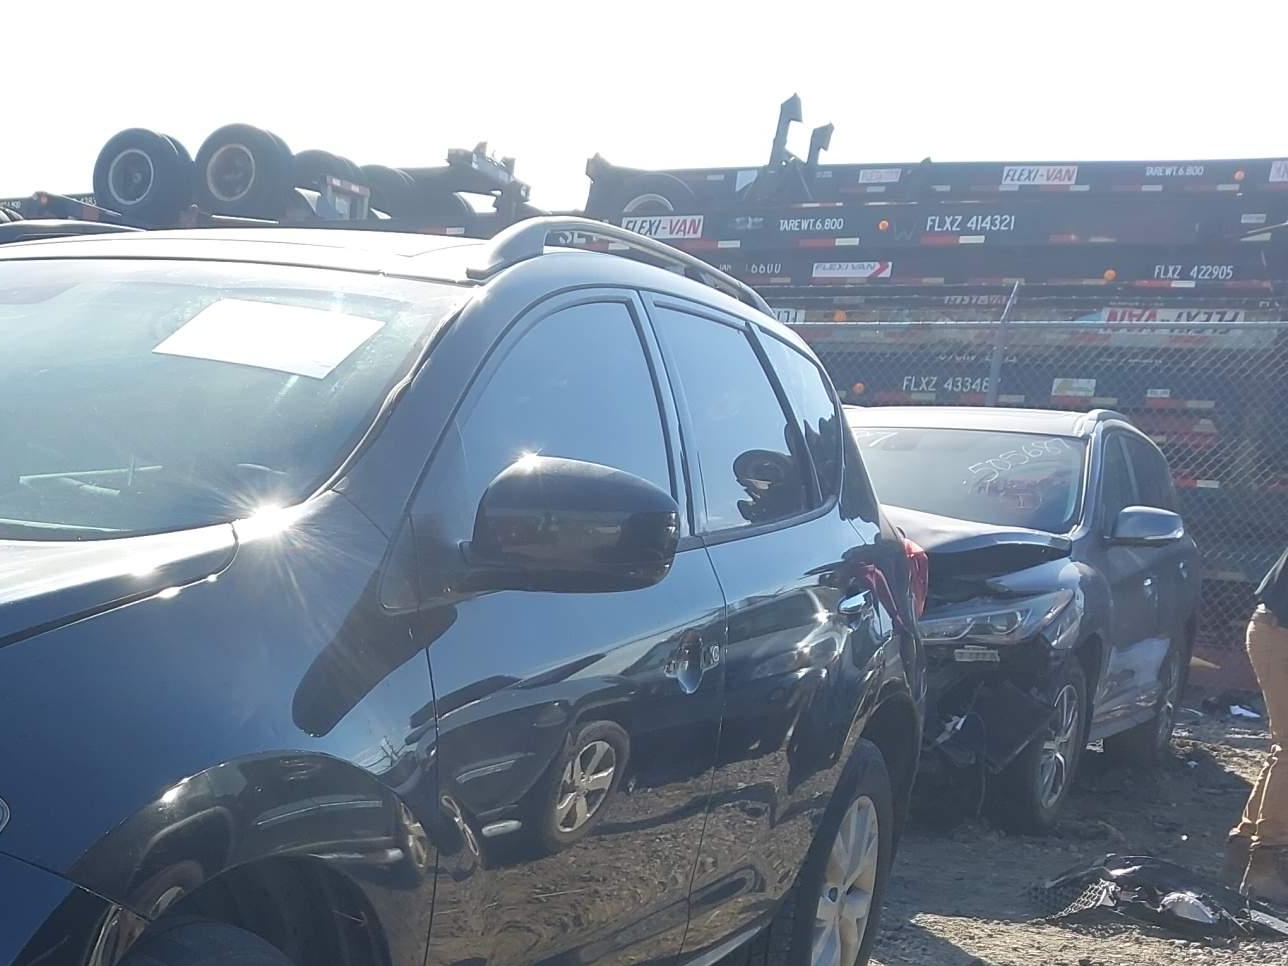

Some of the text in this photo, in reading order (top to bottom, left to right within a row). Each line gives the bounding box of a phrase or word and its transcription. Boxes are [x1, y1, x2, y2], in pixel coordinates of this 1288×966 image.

[1004, 167, 1075, 182] FLEXI-VAN
[926, 215, 1016, 232] FLXZ 414321
[1154, 265, 1234, 279] FLXZ 422905
[902, 376, 938, 391] FLXZ
